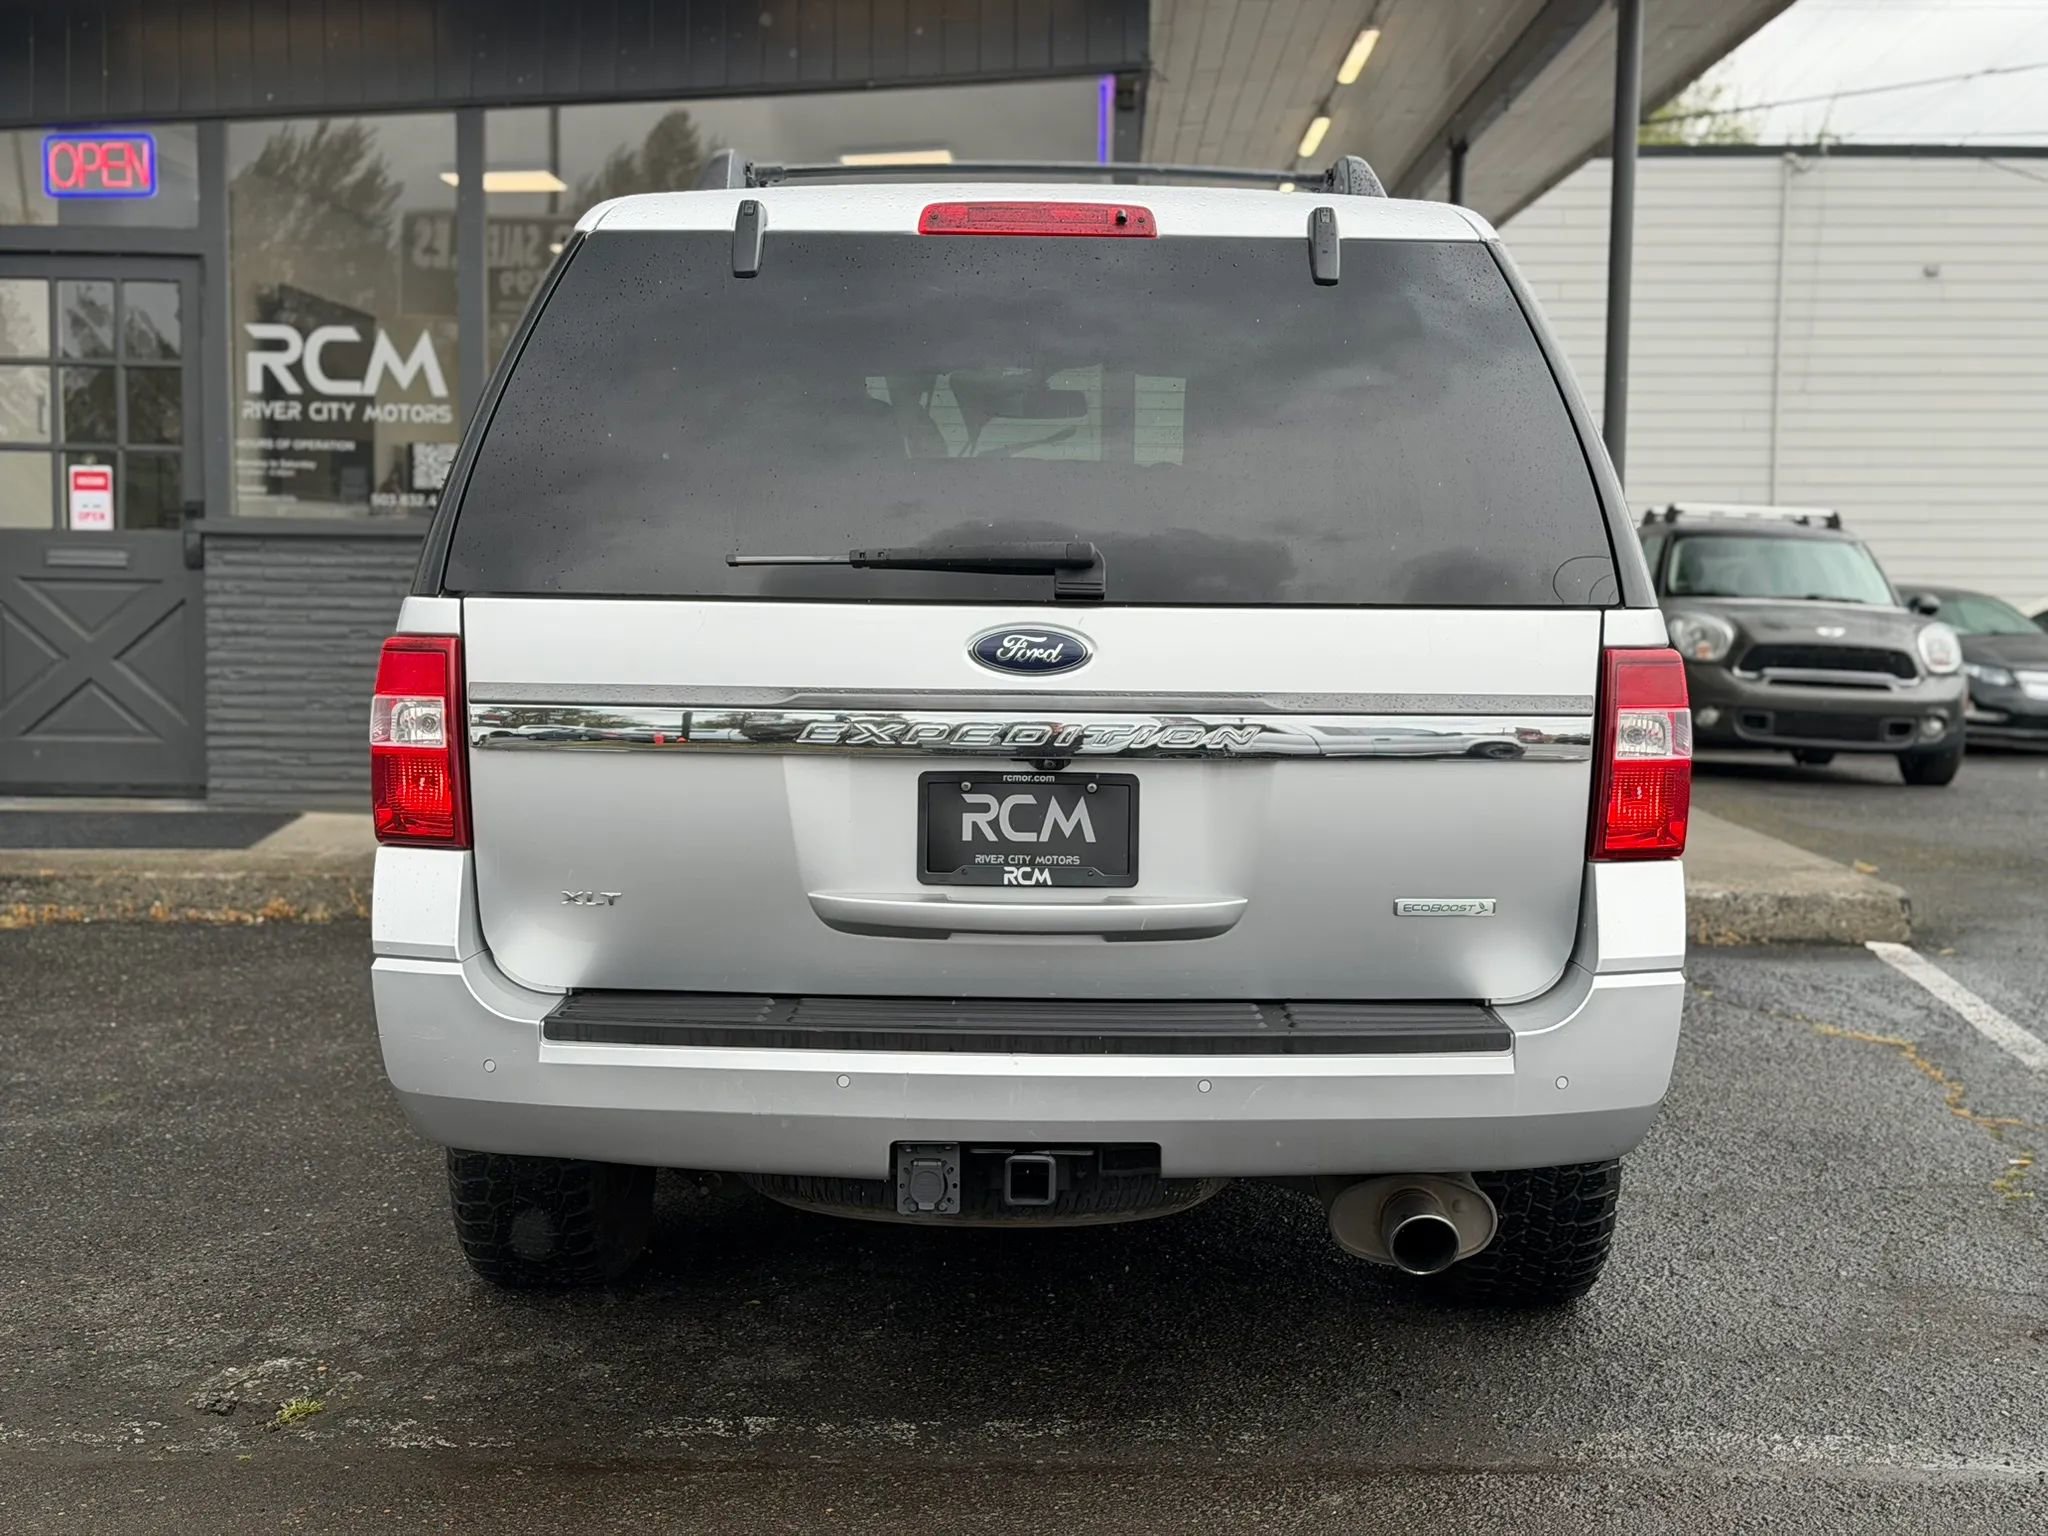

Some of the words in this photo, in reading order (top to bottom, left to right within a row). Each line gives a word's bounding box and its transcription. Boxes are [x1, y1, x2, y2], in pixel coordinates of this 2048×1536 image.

[48, 142, 150, 189] OPEN
[245, 323, 449, 398] RCM
[242, 400, 302, 420] RIVER
[308, 402, 355, 421] CITY
[363, 403, 454, 423] MOTORS
[996, 634, 1064, 663] Ford
[797, 720, 1262, 749] EXPEDITION
[1002, 774, 1055, 783] rcmor.com
[961, 793, 1097, 843] RCM
[975, 854, 1005, 865] RIVER
[1008, 855, 1031, 865] CITY
[1035, 855, 1080, 865] MOTORS
[1003, 866, 1052, 885] RCM
[560, 890, 622, 906] XLT
